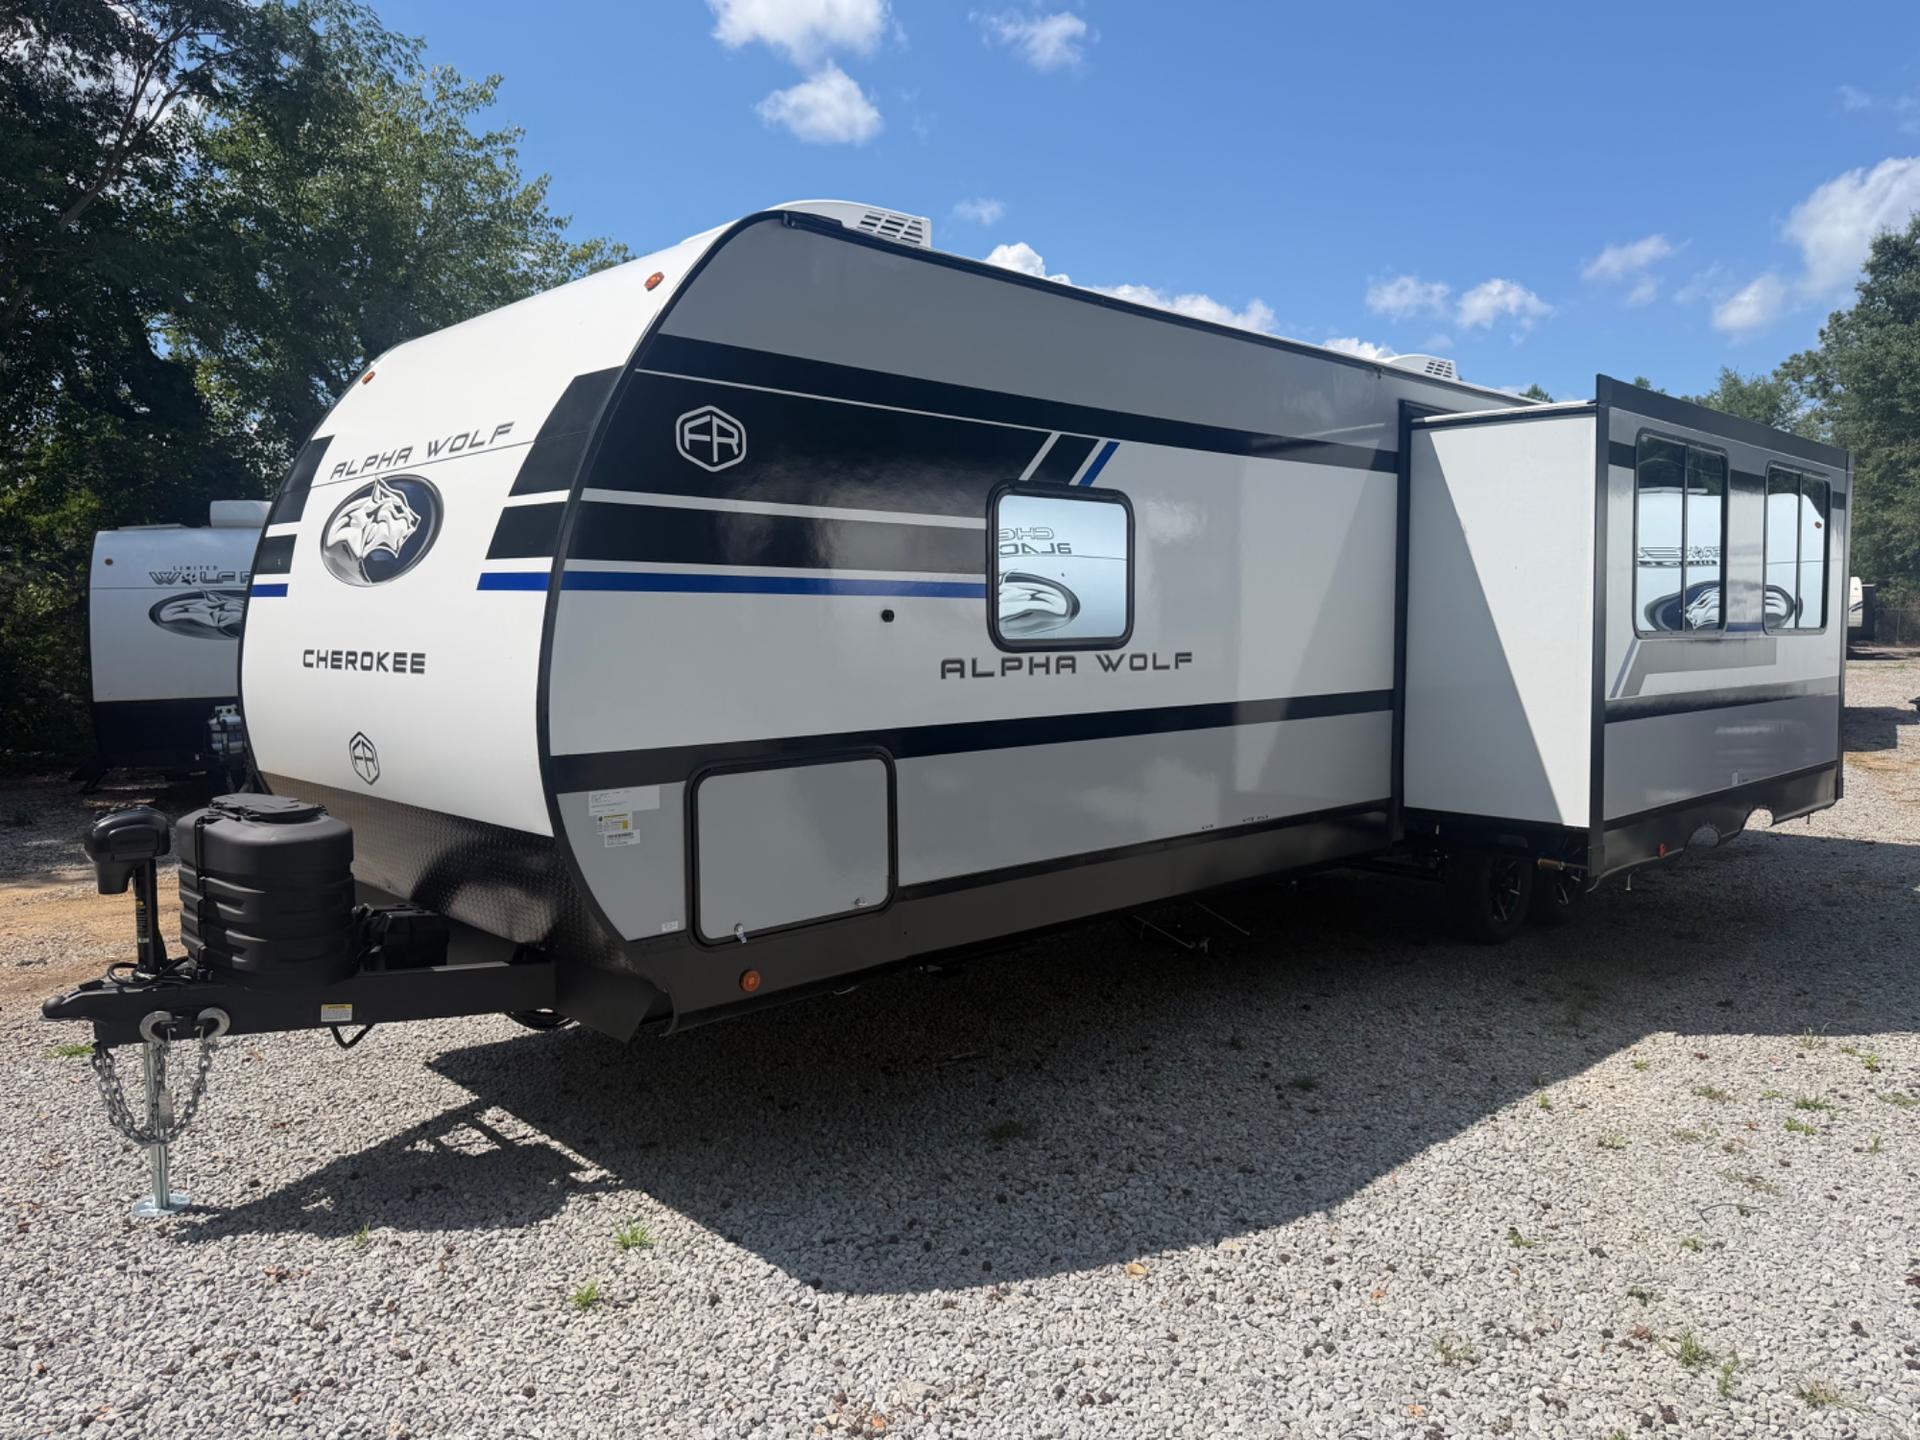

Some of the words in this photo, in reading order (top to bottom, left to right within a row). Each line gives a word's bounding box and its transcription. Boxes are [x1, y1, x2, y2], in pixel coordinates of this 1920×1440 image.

[329, 446, 413, 480] ALPHA
[427, 421, 514, 458] WOLF
[303, 649, 426, 674] CHEROKEE
[940, 655, 1077, 680] ALPHA
[1095, 652, 1193, 672] WOLF
